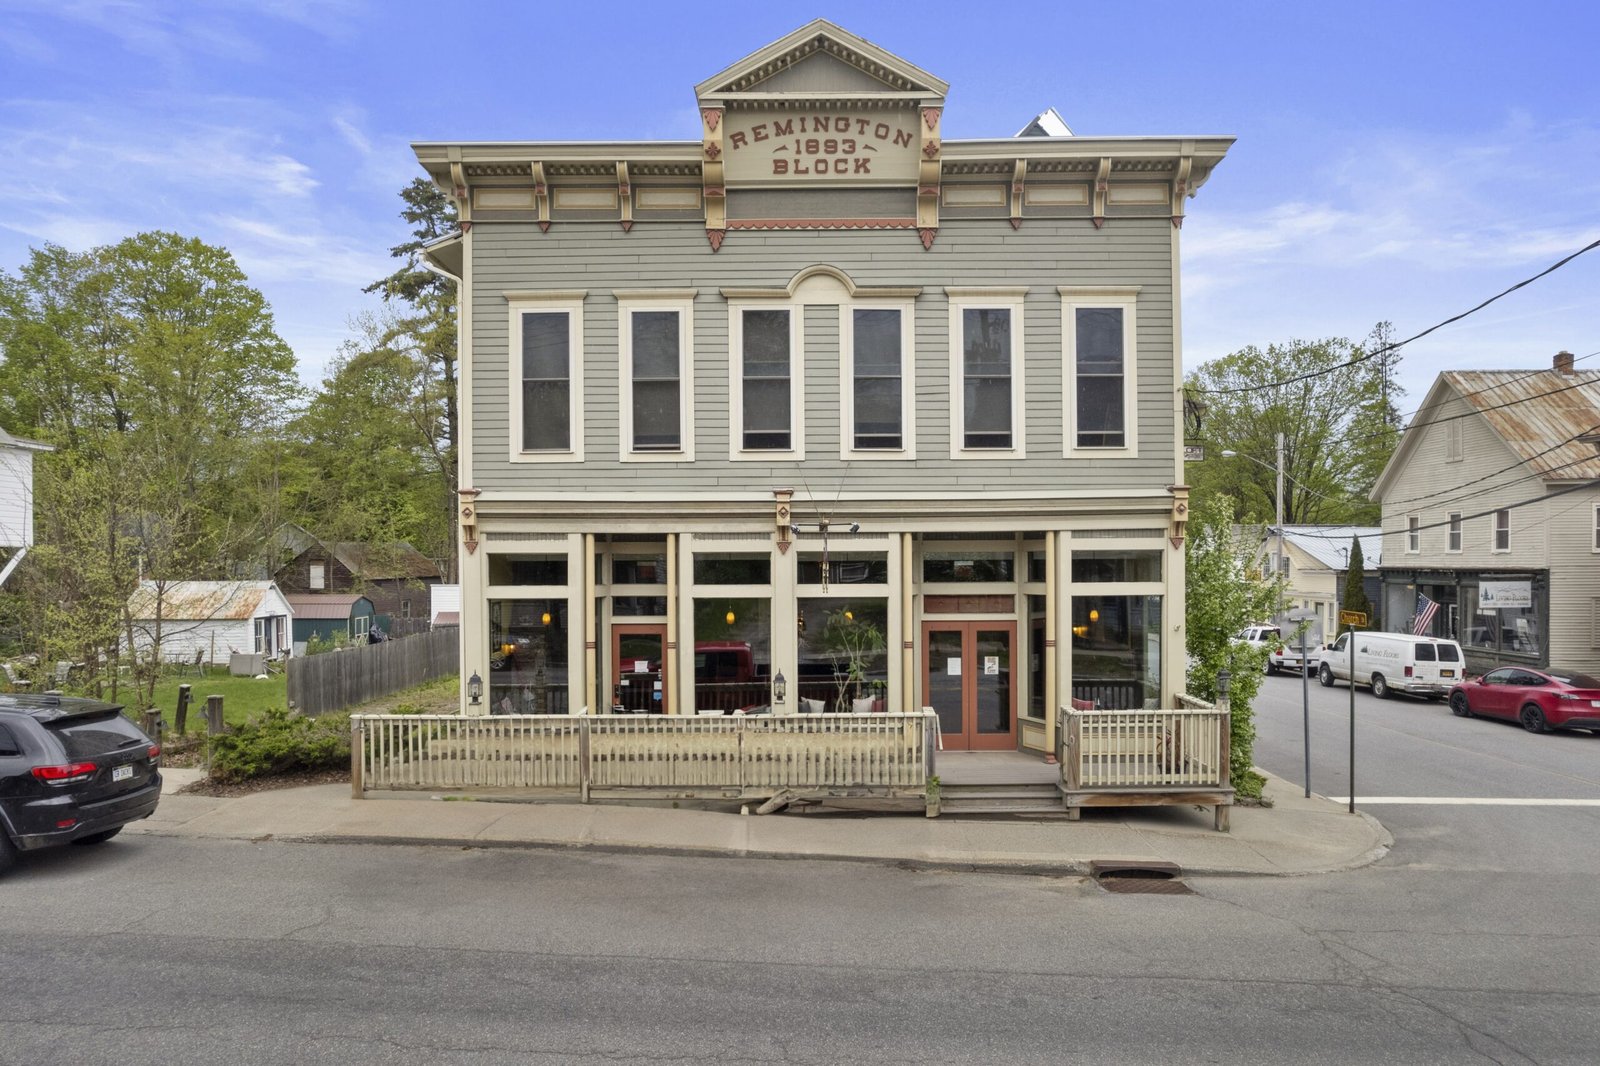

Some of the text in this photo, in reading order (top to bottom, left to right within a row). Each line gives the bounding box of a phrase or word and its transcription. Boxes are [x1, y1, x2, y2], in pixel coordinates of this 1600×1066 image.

[729, 116, 913, 150] REMINGTON
[795, 138, 856, 155] 1893
[773, 158, 871, 175] BLOCK
